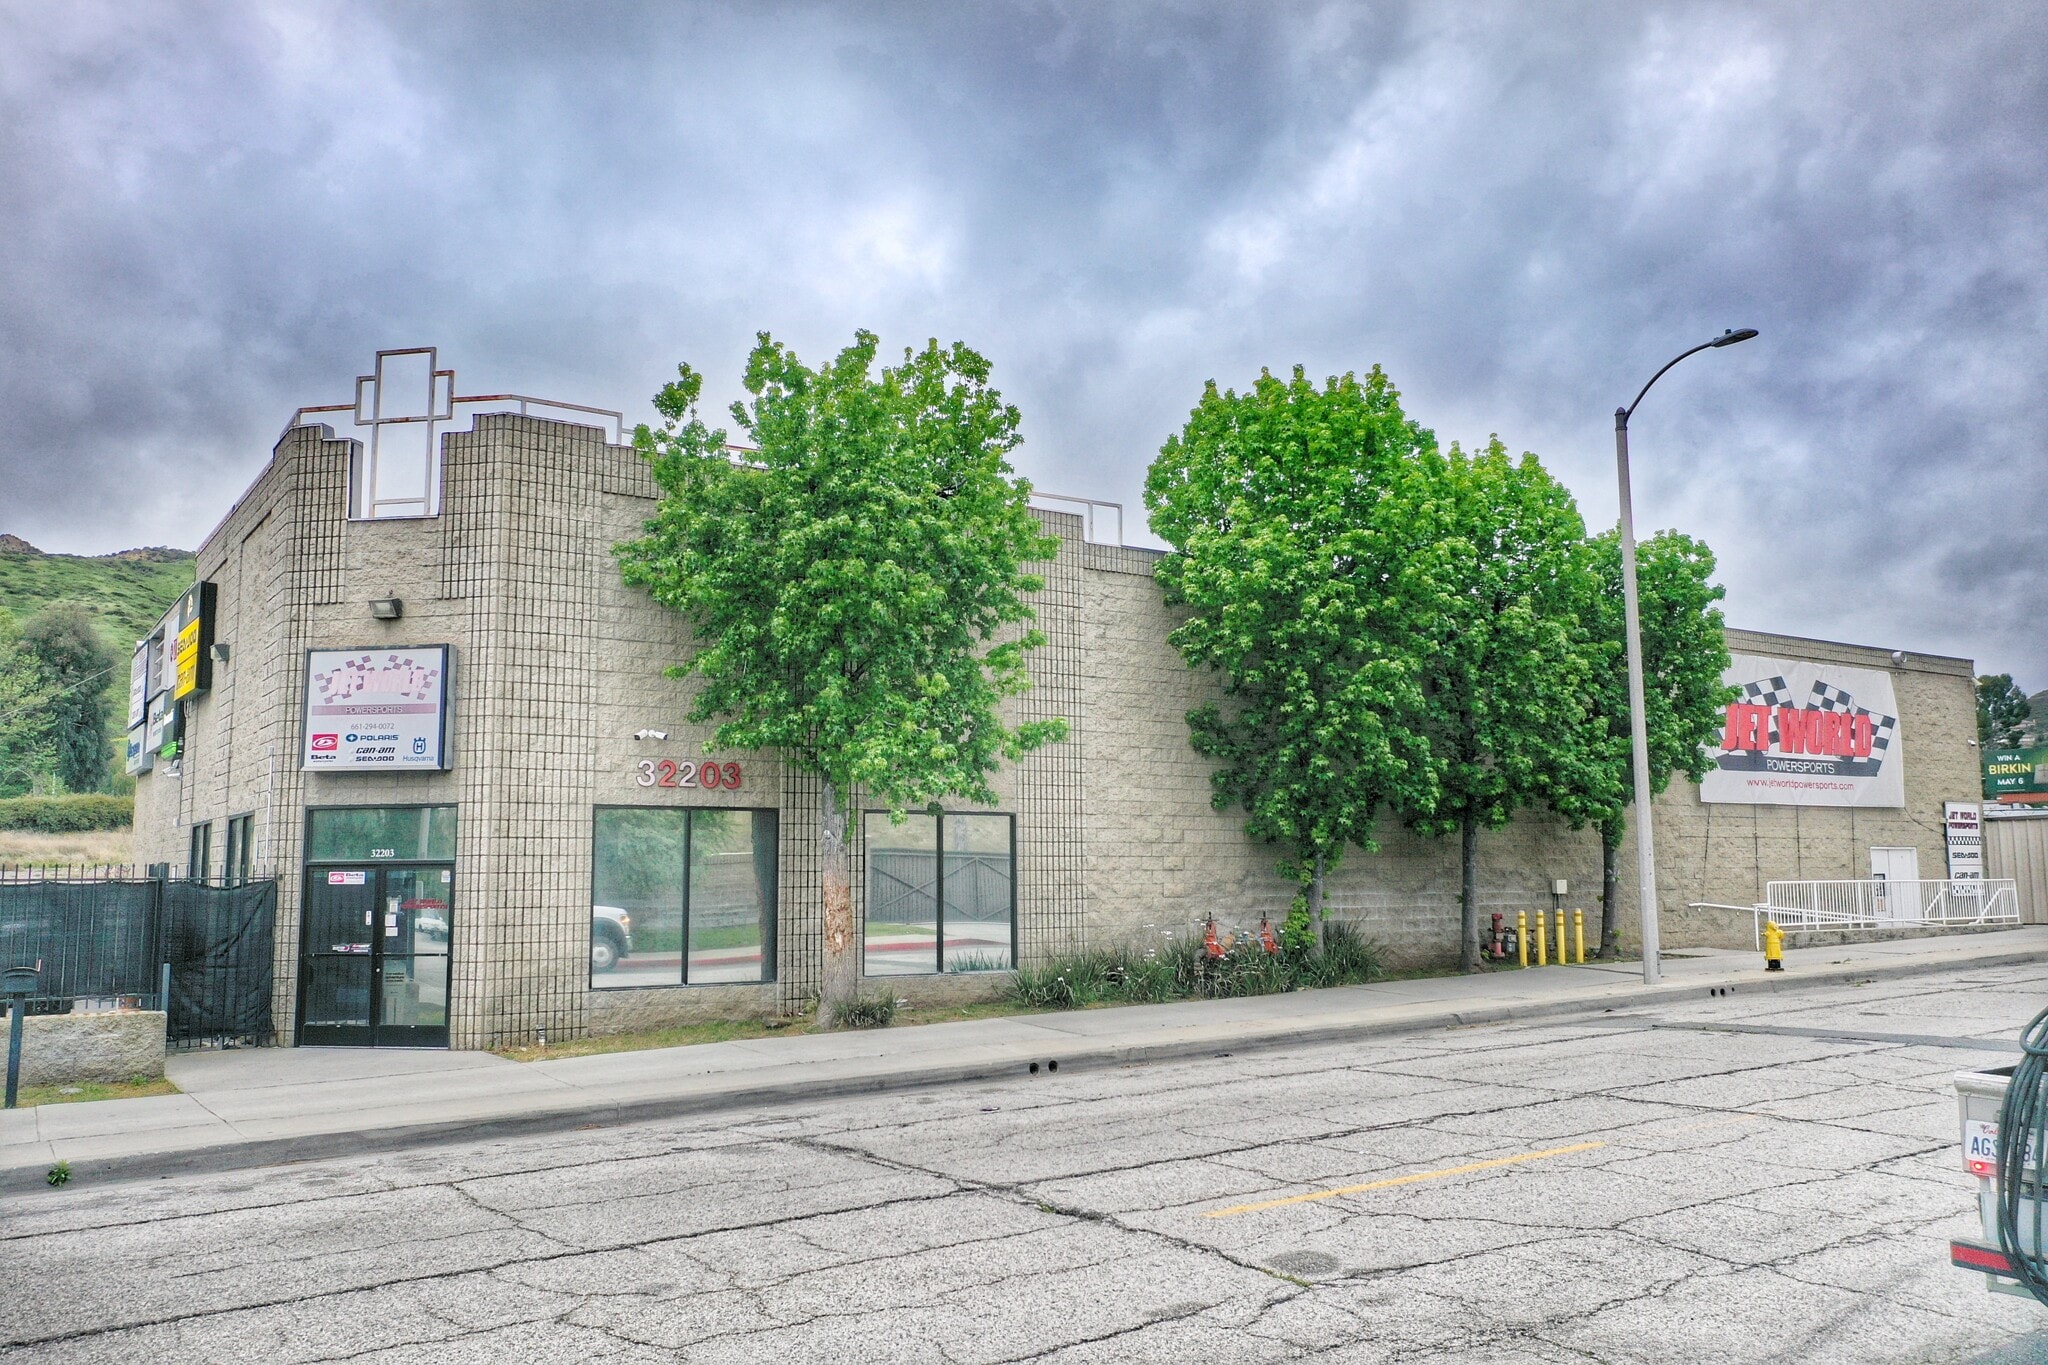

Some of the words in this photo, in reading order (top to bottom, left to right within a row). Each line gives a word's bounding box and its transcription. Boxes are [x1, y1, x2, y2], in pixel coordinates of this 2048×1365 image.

[346, 705, 403, 714] POWERSPORTS
[1720, 703, 1772, 751] JET
[1777, 706, 1872, 757] WORLD
[1766, 759, 1836, 774] POWERSPORTS
[1988, 762, 2032, 775] BIRKIN
[636, 759, 742, 789] 32203
[1746, 778, 1854, 791] www.jetworldpowersports.com
[2017, 777, 2024, 785] 6
[1948, 811, 1958, 820] JET
[1959, 811, 1977, 820] WORLD
[370, 848, 395, 858] 32203
